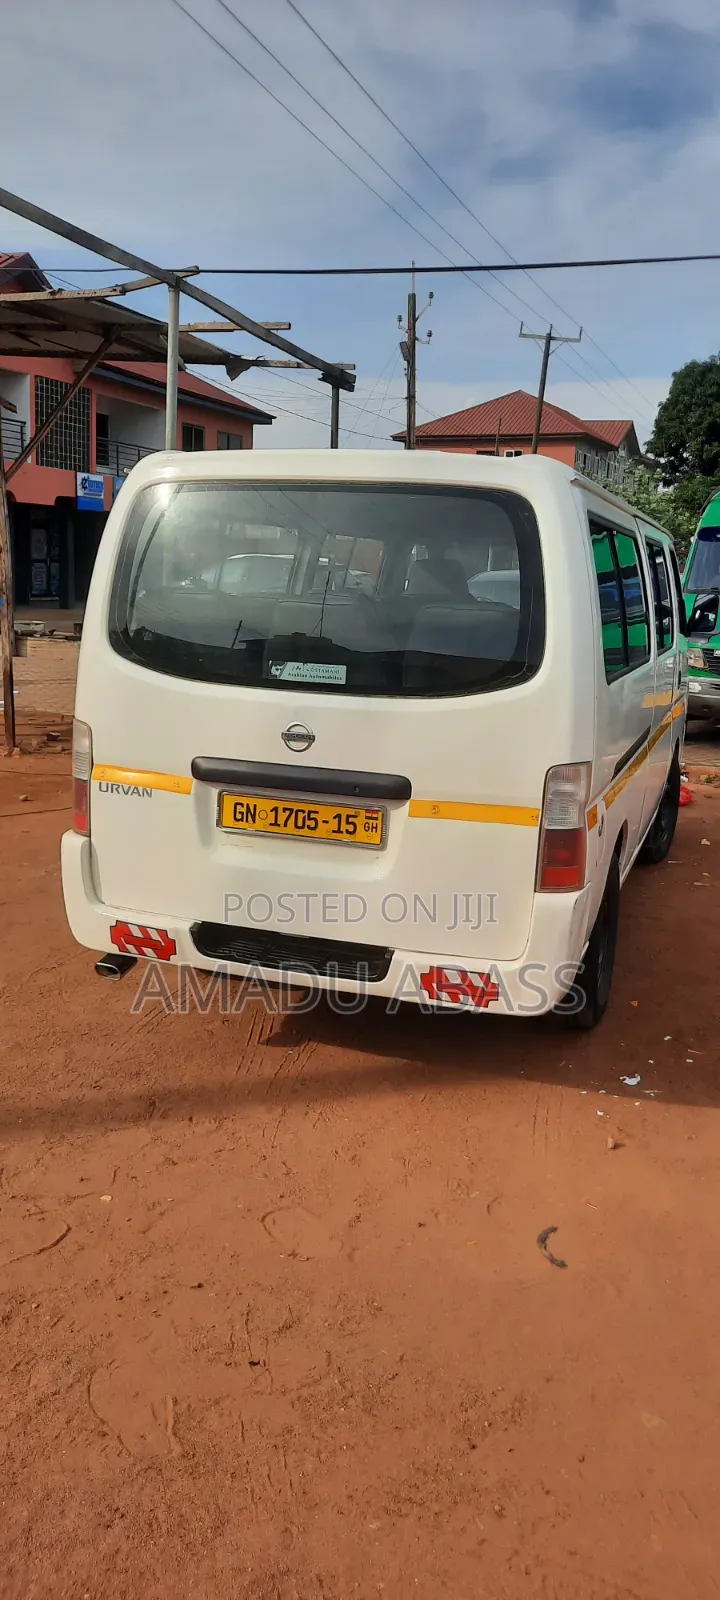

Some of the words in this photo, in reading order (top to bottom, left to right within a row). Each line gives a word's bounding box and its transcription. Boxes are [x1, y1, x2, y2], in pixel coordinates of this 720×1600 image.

[98, 781, 153, 798] URVAN
[233, 801, 257, 824] GN
[269, 806, 358, 835] 1705-15
[363, 821, 378, 833] GH
